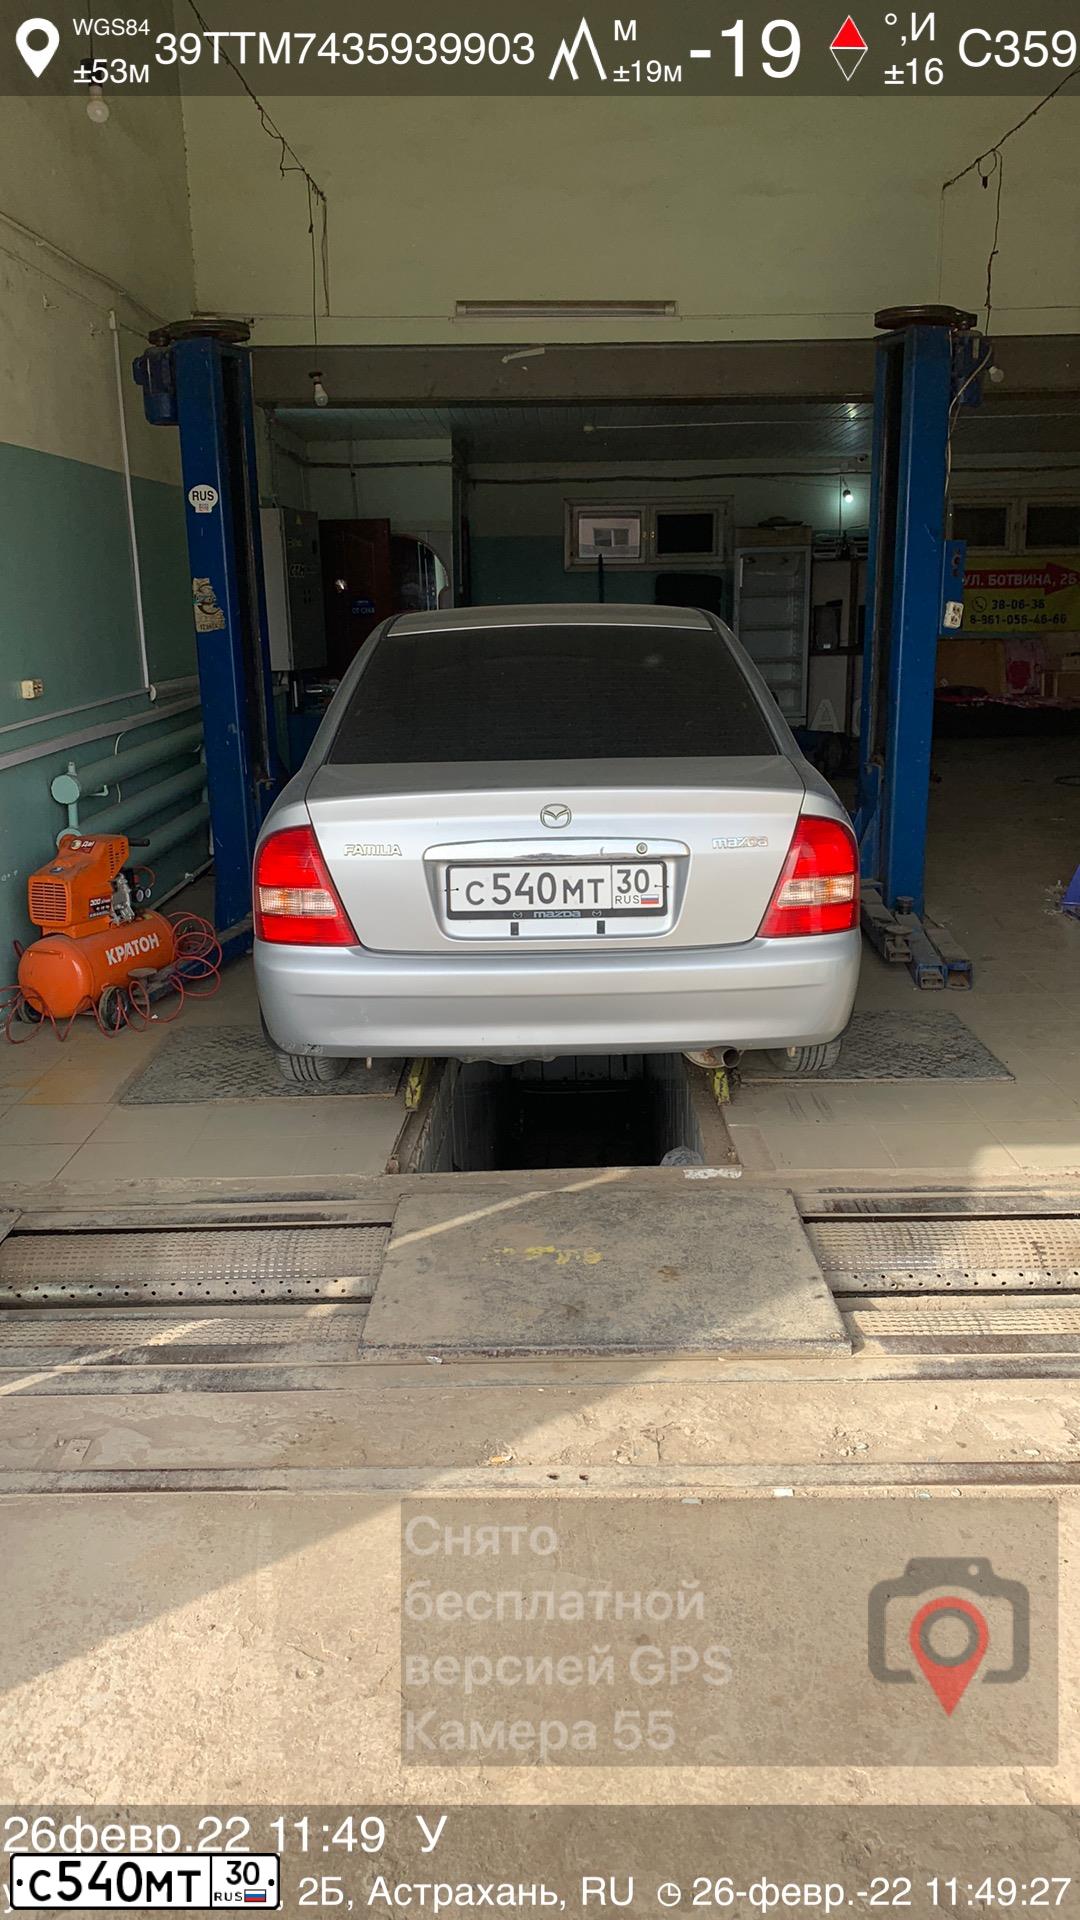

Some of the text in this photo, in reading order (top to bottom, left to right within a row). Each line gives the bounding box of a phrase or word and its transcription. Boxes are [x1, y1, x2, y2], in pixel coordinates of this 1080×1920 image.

[192, 490, 214, 501] RUS
[344, 843, 402, 857] FAMILIA
[617, 869, 650, 894] 30
[615, 895, 640, 905] RUS
[105, 932, 160, 966] КРАТОН
